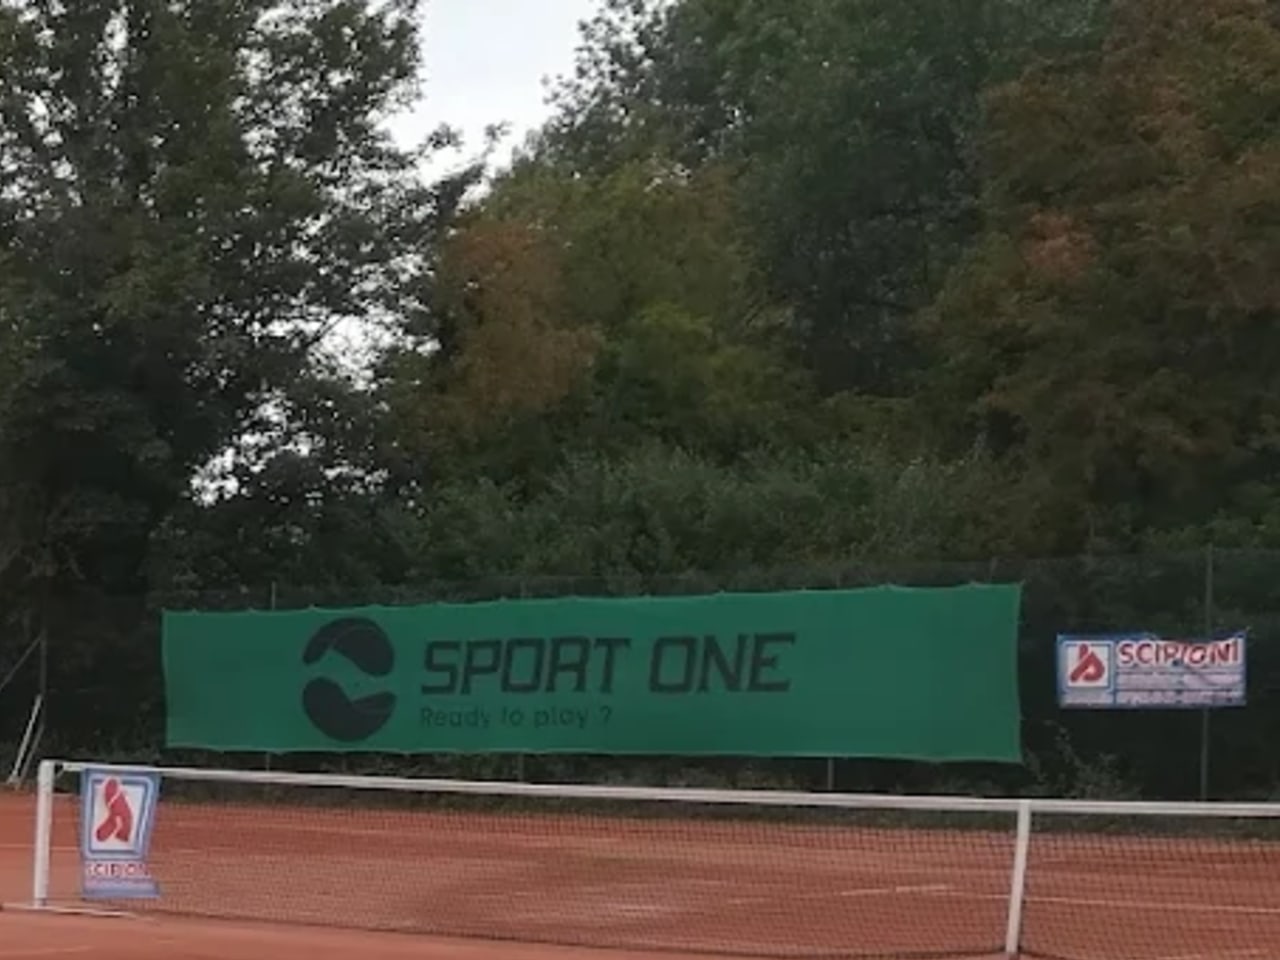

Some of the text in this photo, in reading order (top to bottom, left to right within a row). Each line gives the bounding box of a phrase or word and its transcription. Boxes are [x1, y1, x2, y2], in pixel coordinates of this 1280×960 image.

[420, 632, 796, 696] SPORT ONE
[1119, 641, 1239, 665] SCIPIONI
[419, 705, 613, 728] Ready to play ?
